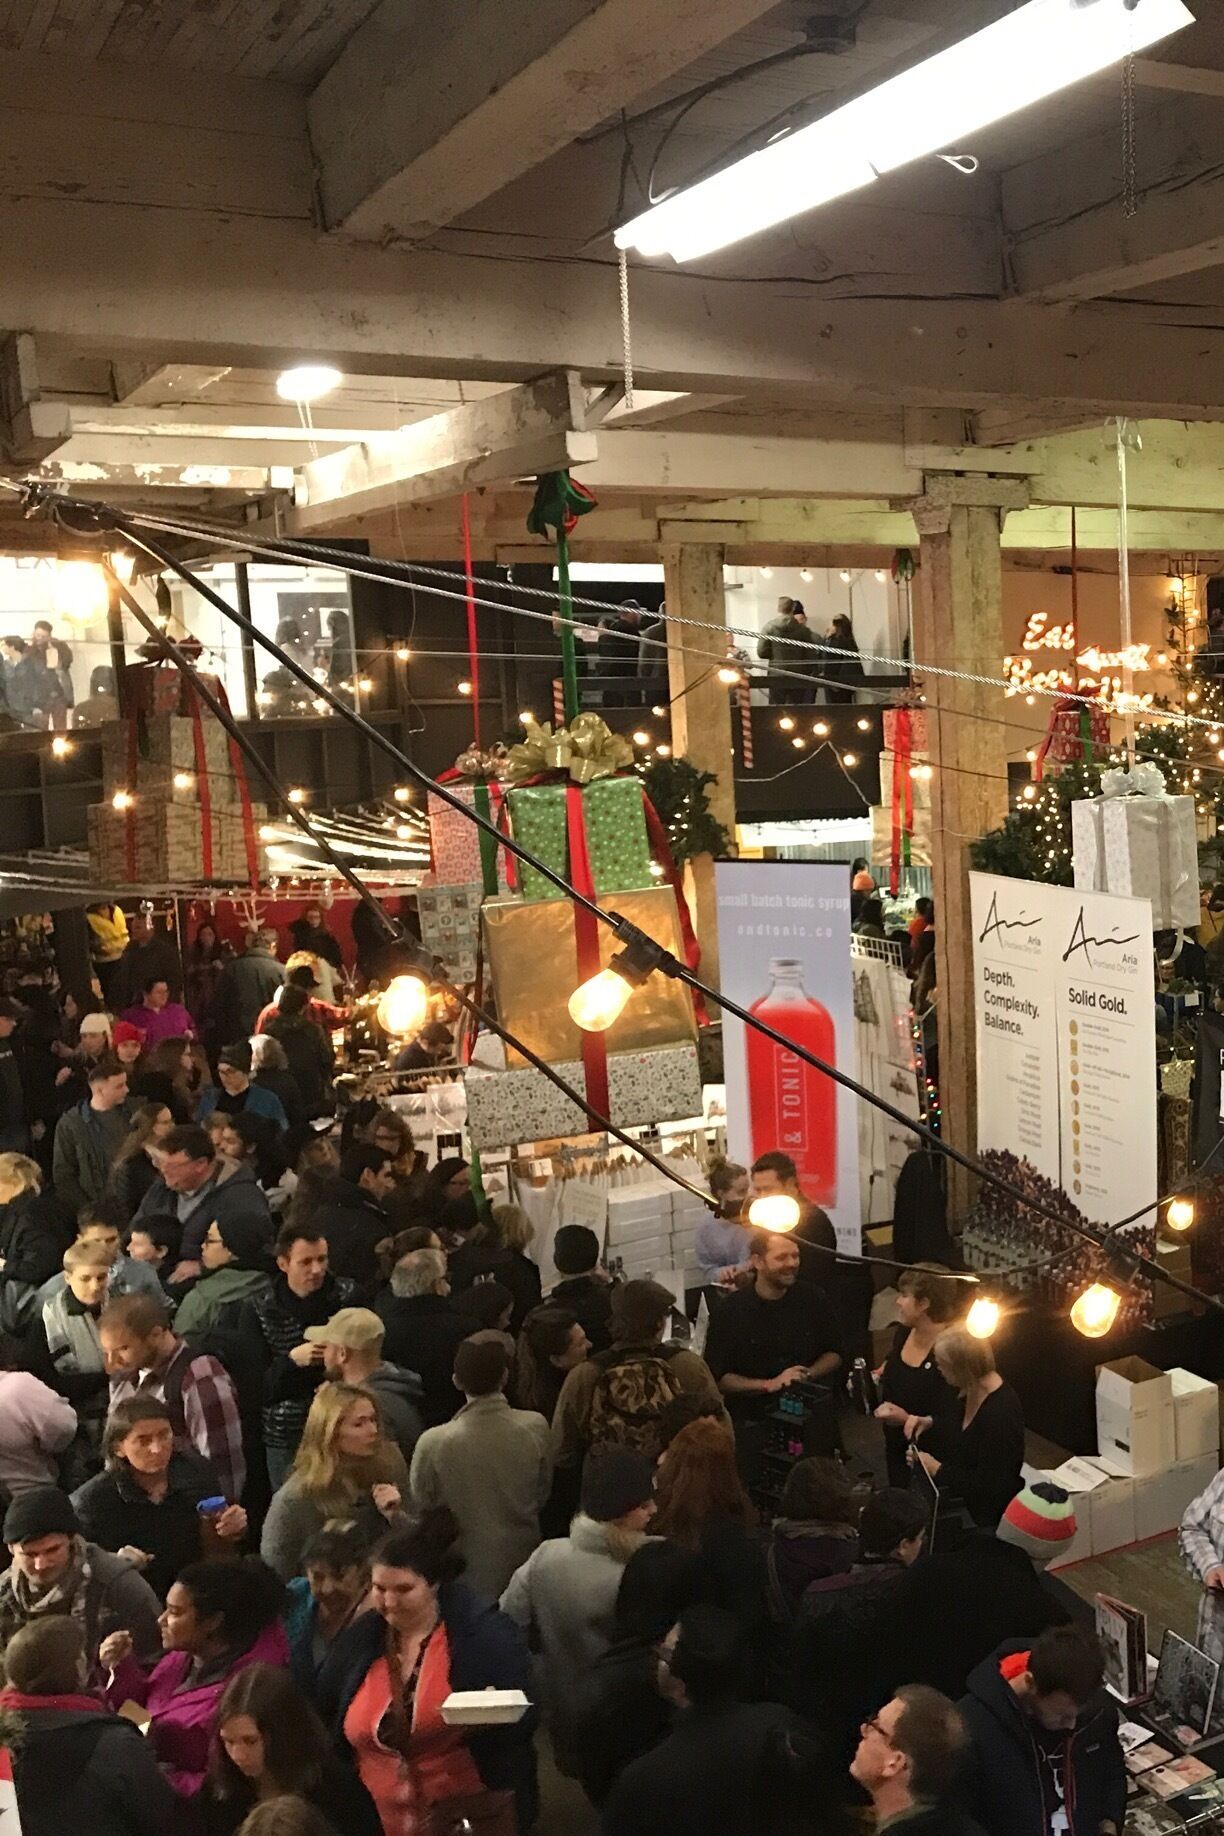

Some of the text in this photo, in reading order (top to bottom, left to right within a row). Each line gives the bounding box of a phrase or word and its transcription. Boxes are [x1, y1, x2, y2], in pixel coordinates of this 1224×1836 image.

[751, 894, 783, 907] batch
[786, 895, 815, 908] tonic
[818, 897, 850, 911] syrup
[1027, 935, 1041, 946] Aria
[1121, 953, 1138, 966] Aria
[983, 966, 1015, 988] Depth.
[983, 990, 1040, 1020] Complexity.
[1068, 987, 1128, 1015] Solid Gold.
[984, 1012, 1024, 1035] Balance.
[781, 1050, 801, 1119] TONIC
